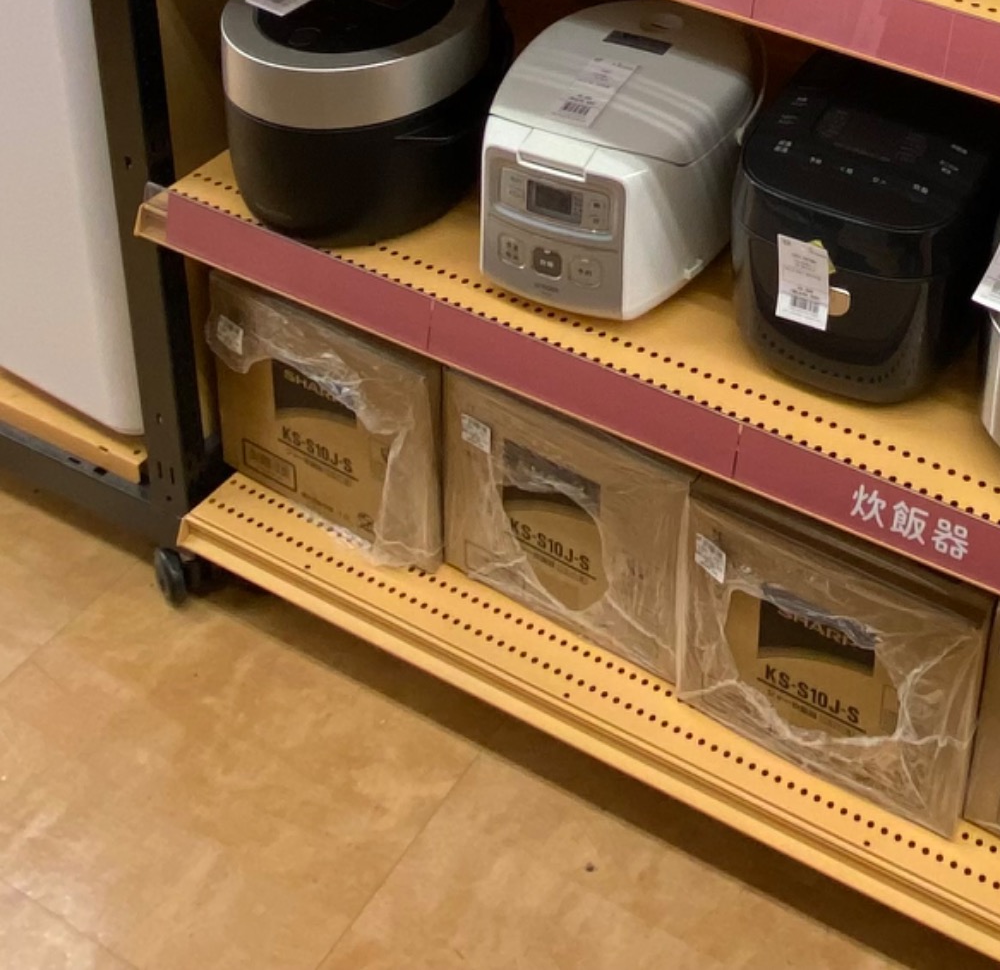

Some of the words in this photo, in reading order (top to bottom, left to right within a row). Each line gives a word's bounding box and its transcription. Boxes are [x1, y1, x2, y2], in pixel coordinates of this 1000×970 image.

[282, 425, 354, 474] KS-S10J-S
[510, 517, 591, 572] KS-S10J-S
[850, 484, 969, 560] 炊飯器
[764, 664, 860, 725] KS-S10J-S
